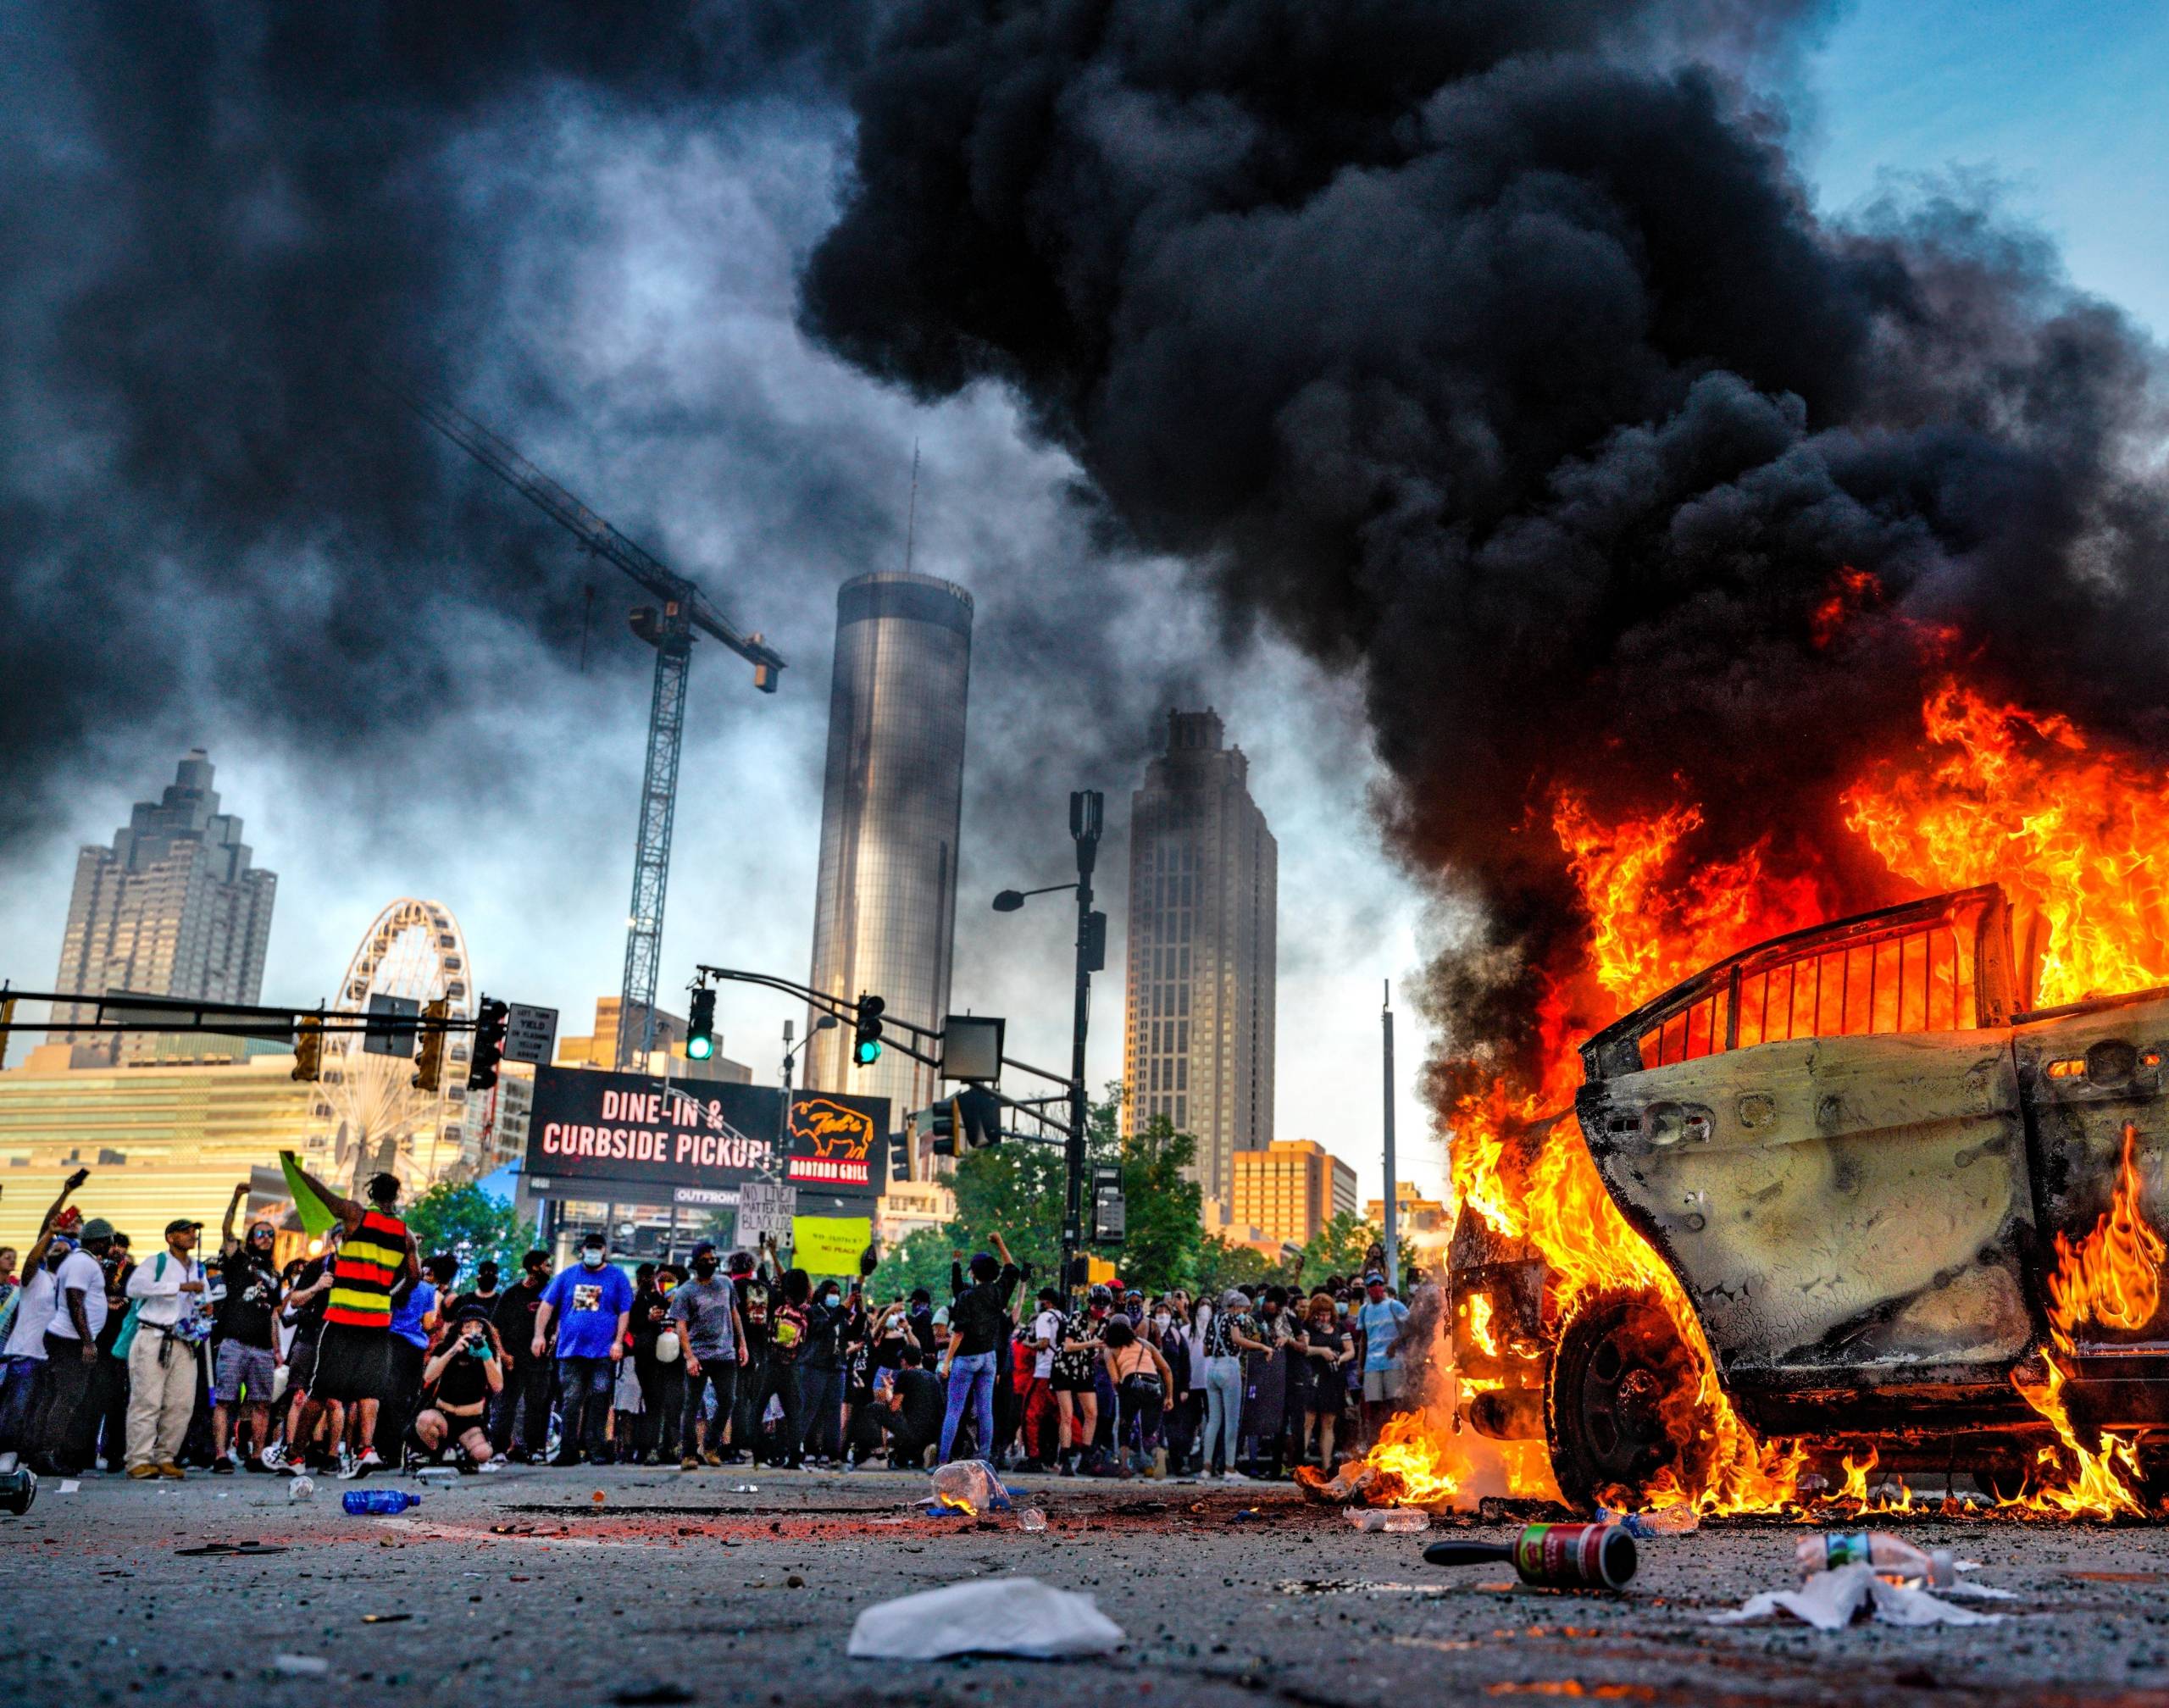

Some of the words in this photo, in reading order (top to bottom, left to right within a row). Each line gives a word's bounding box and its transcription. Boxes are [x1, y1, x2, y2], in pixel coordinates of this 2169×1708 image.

[521, 1019, 545, 1030] YIELD
[602, 1090, 699, 1127] DINE-IN
[706, 1099, 724, 1130] &
[543, 1123, 668, 1162] CURBSIDE
[674, 1133, 773, 1170] PICKUP!
[789, 1159, 838, 1179] MONTANA
[839, 1162, 868, 1181] GRILL
[677, 1189, 741, 1205] OUTFRONT
[742, 1184, 758, 1201] NO
[764, 1185, 792, 1203] LIVES
[741, 1201, 777, 1214] MATTER
[741, 1213, 774, 1230] BLACK
